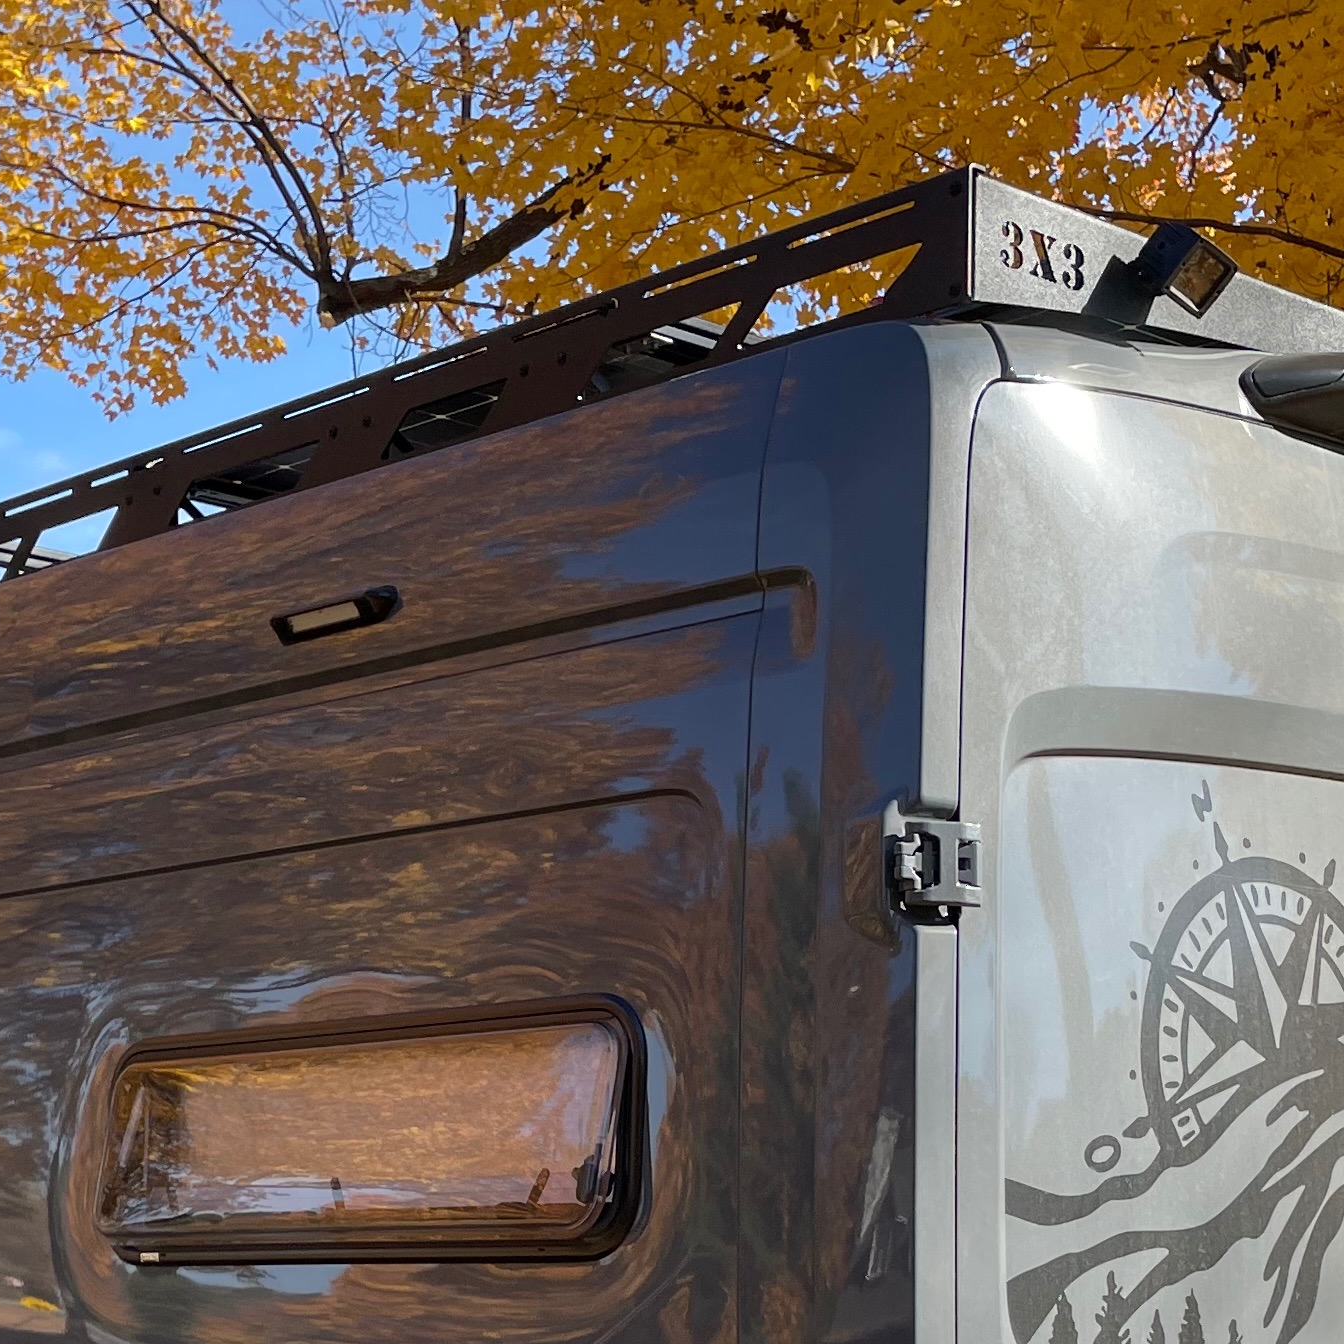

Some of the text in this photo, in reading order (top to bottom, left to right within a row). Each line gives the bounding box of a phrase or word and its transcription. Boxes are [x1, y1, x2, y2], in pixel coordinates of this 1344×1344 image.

[1000, 220, 1085, 291] 3X3
[1191, 779, 1213, 822] N
[1084, 1134, 1122, 1173] O
